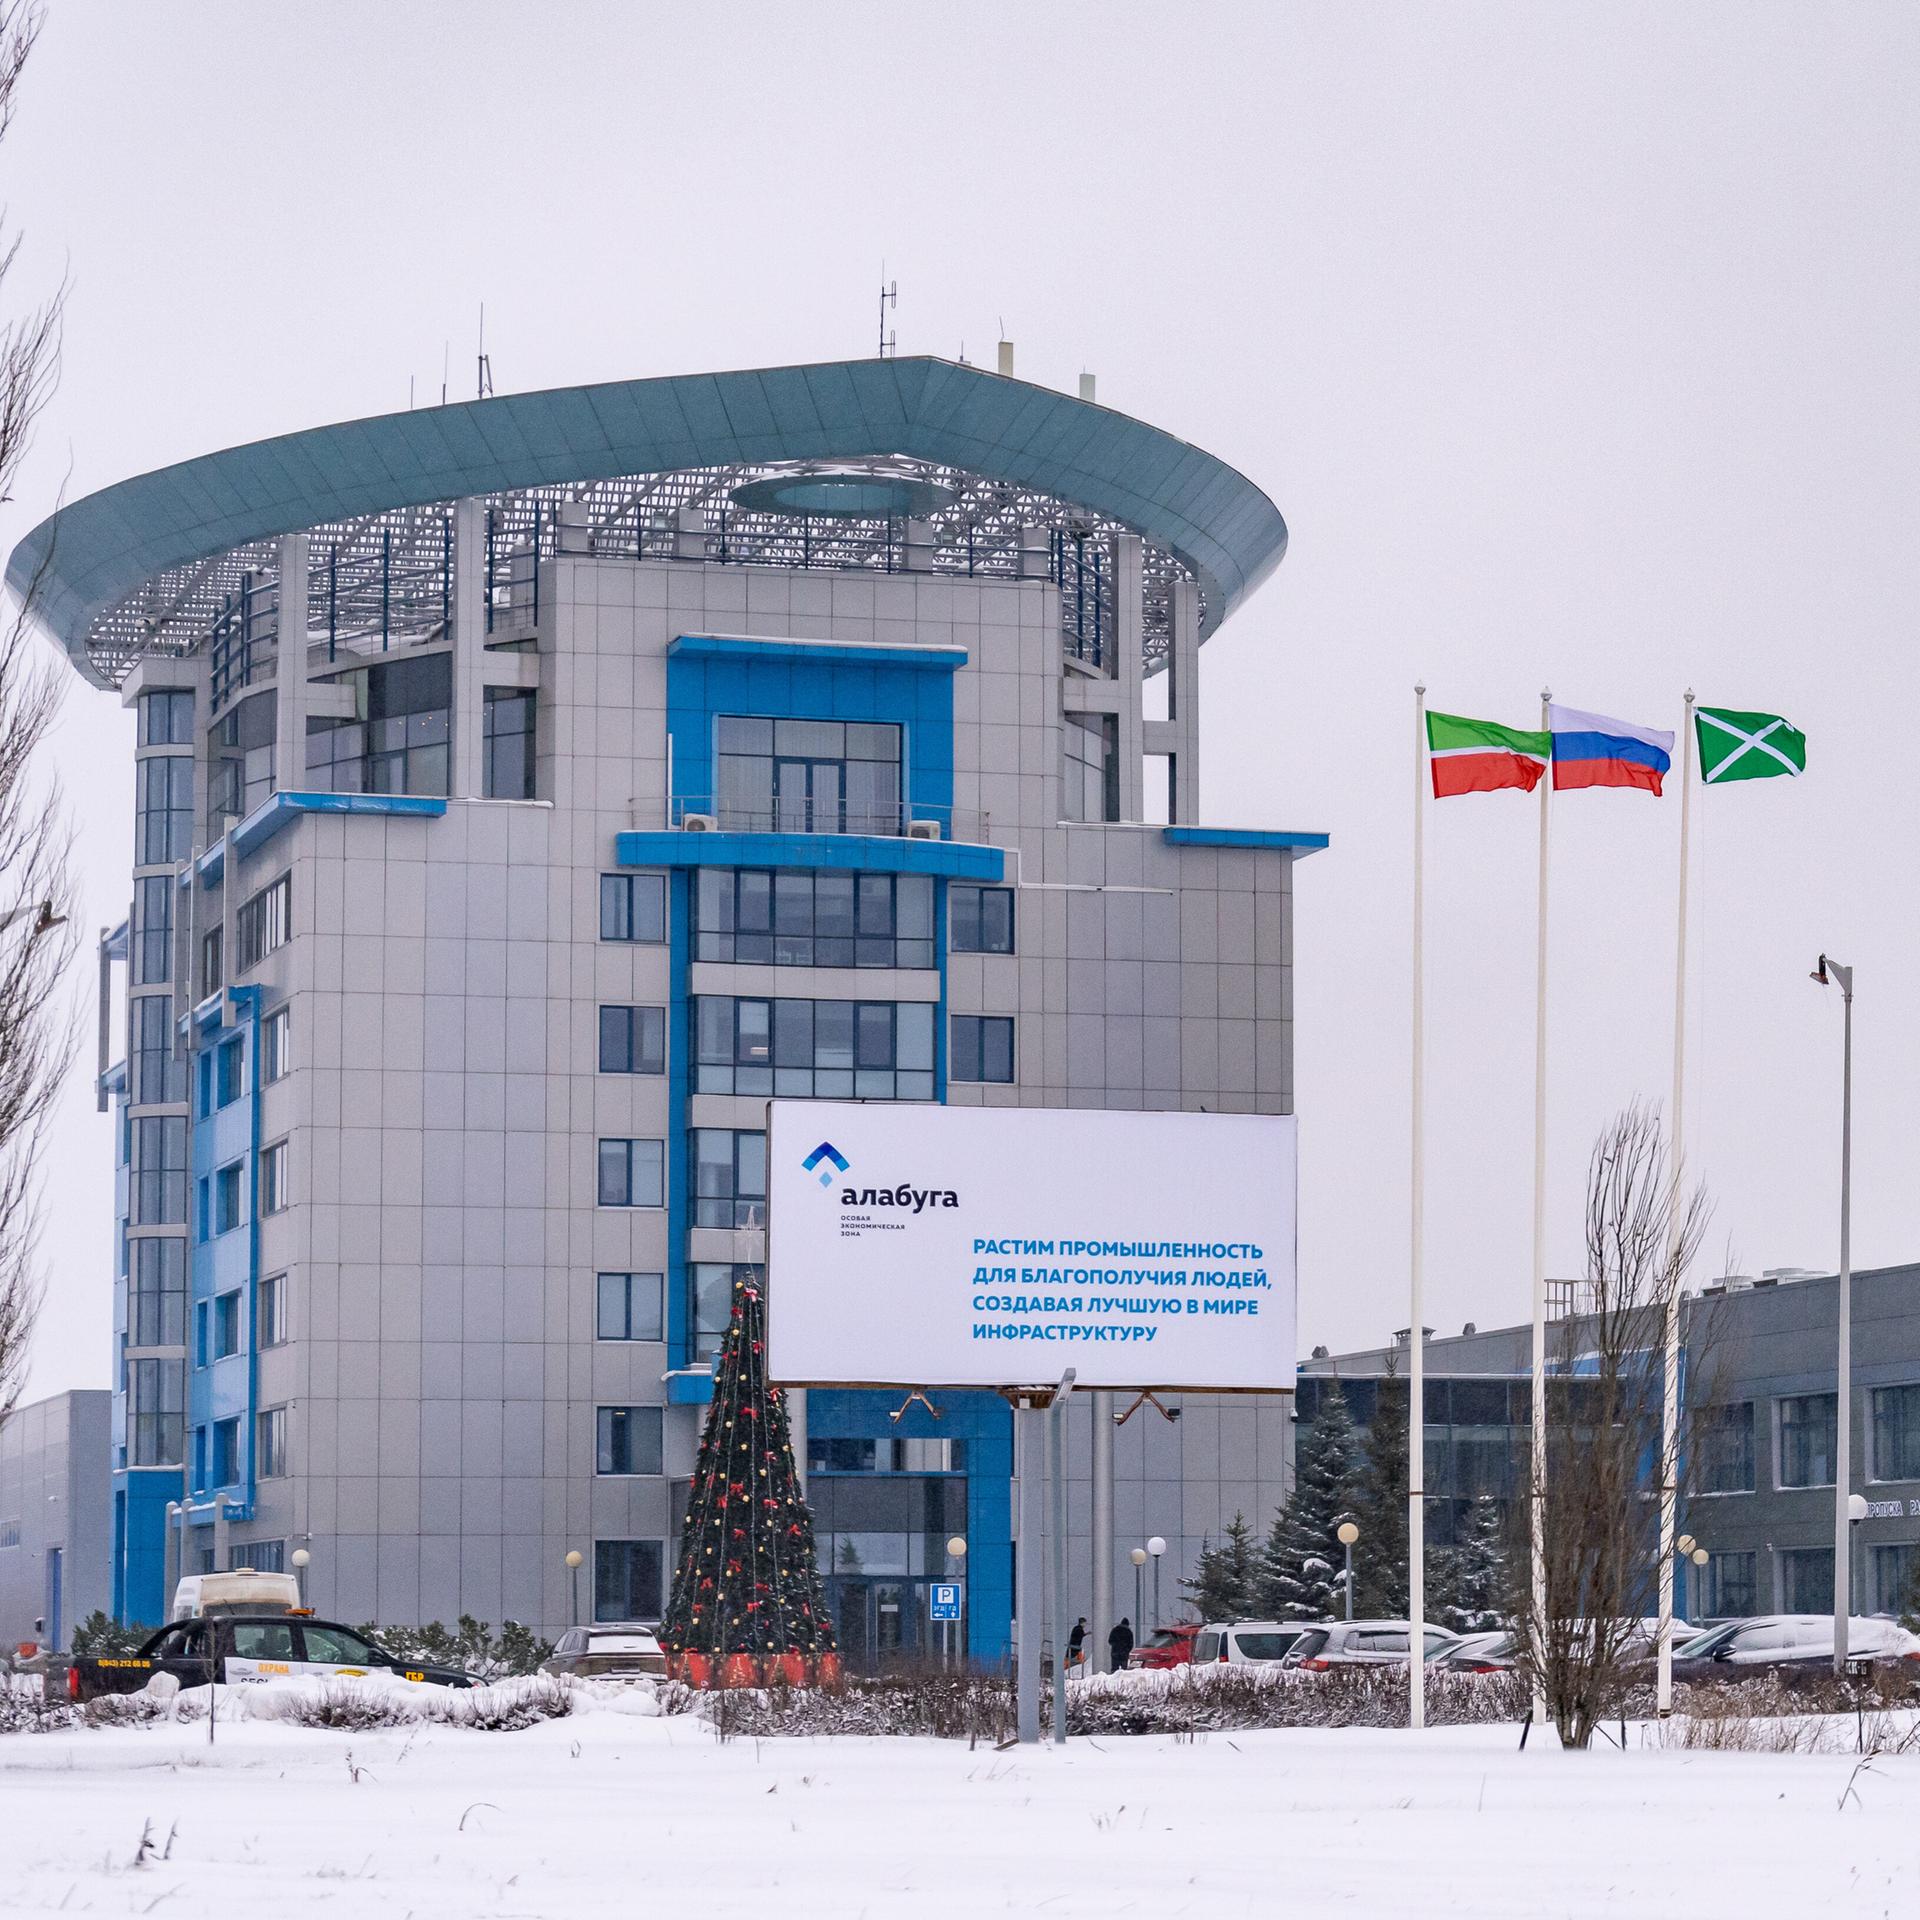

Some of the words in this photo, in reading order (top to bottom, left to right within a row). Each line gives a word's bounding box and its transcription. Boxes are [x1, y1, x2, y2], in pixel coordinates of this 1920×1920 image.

[841, 1184, 960, 1214] алабуга
[973, 1239, 1054, 1255] РАСТИМ
[1060, 1241, 1263, 1259] ПРОМЫШЛЕННОСТЬ
[973, 1268, 1016, 1285] ДЛЯ
[1021, 1269, 1187, 1286] БЛАГОПОЛУЧИЯ
[1191, 1269, 1272, 1290] ЛЮДЕЙ,
[973, 1296, 1083, 1314] СОЗДАВАЯ
[1087, 1297, 1182, 1314] ЛУЧШУЮ
[1187, 1299, 1199, 1314] В
[1204, 1299, 1259, 1315] МИРЕ
[973, 1324, 1158, 1342] ИНФРАСТРУКТУРУ
[258, 1663, 289, 1674] ОХРАНА
[405, 1671, 425, 1682] ГБР
